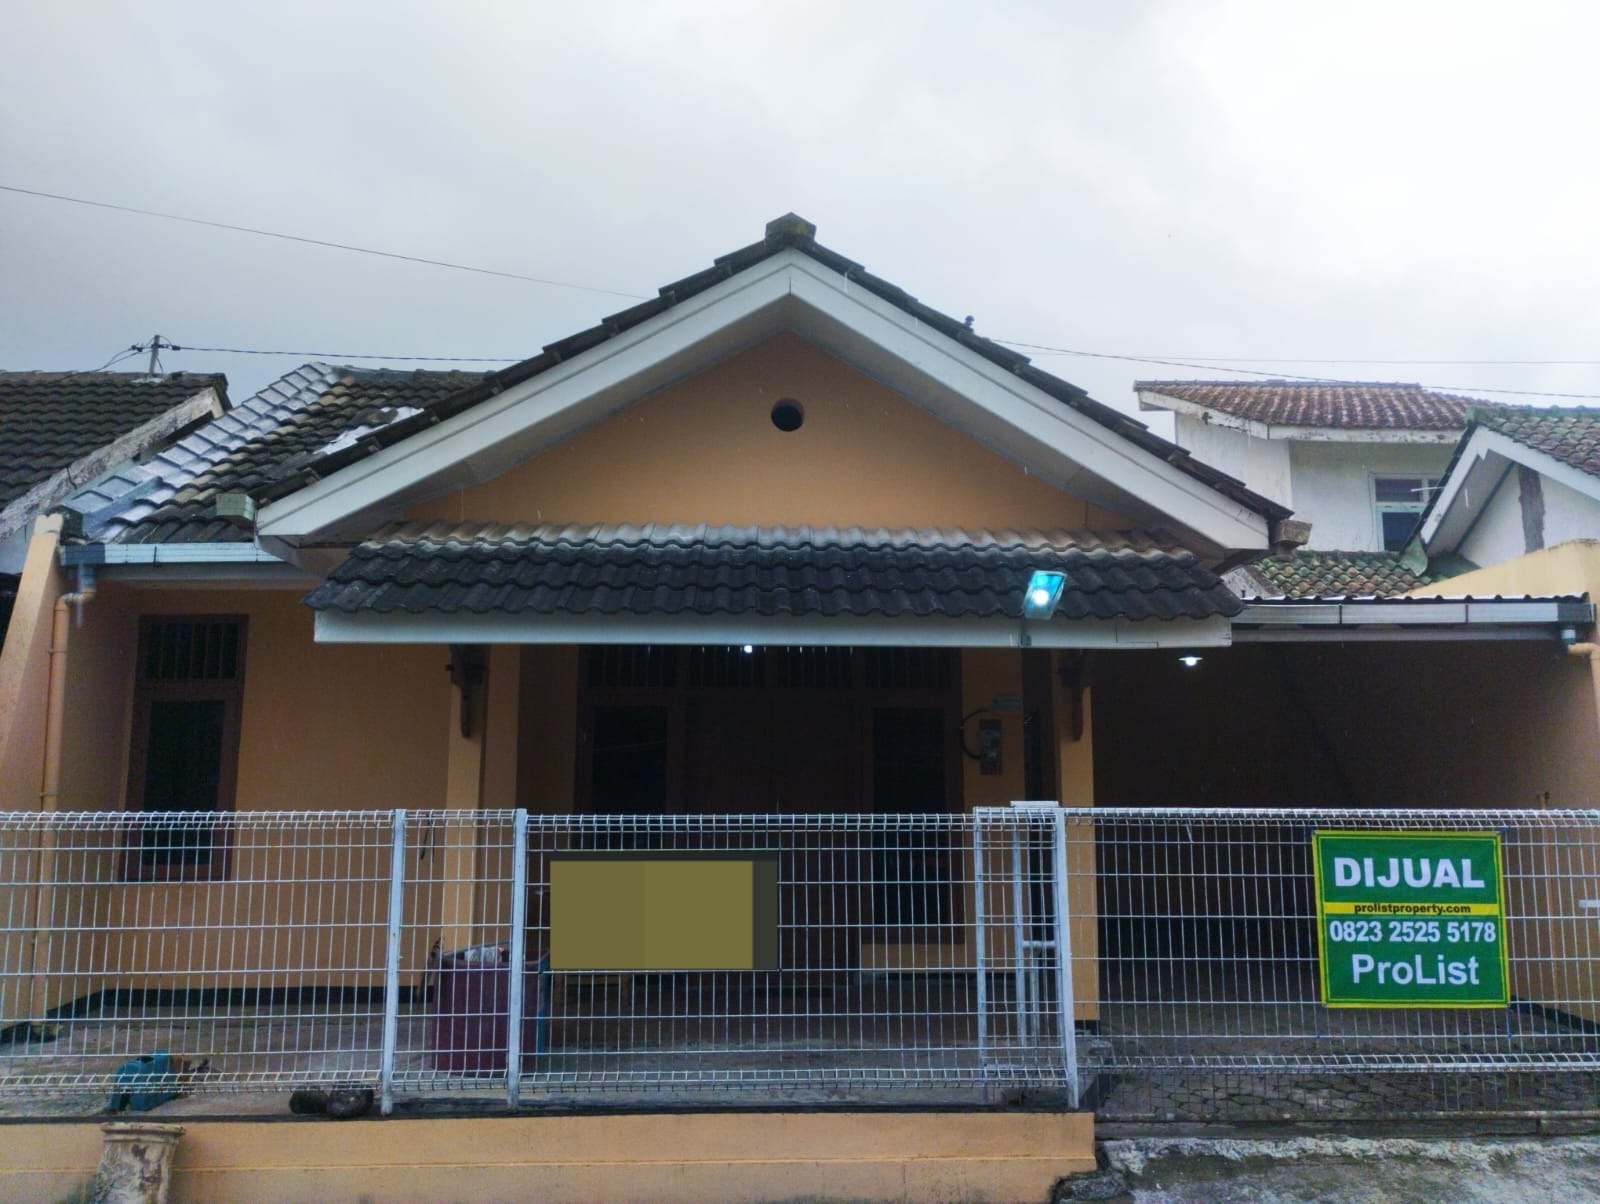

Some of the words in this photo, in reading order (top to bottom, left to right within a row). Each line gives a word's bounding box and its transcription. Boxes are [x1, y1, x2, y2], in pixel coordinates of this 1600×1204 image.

[1334, 857, 1485, 888] DIJUAL
[1354, 903, 1471, 915] prolistproperty.com
[1330, 920, 1383, 942] 0823
[1389, 921, 1440, 942] 2525
[1447, 922, 1496, 943] 5178
[1352, 954, 1480, 985] ProList
